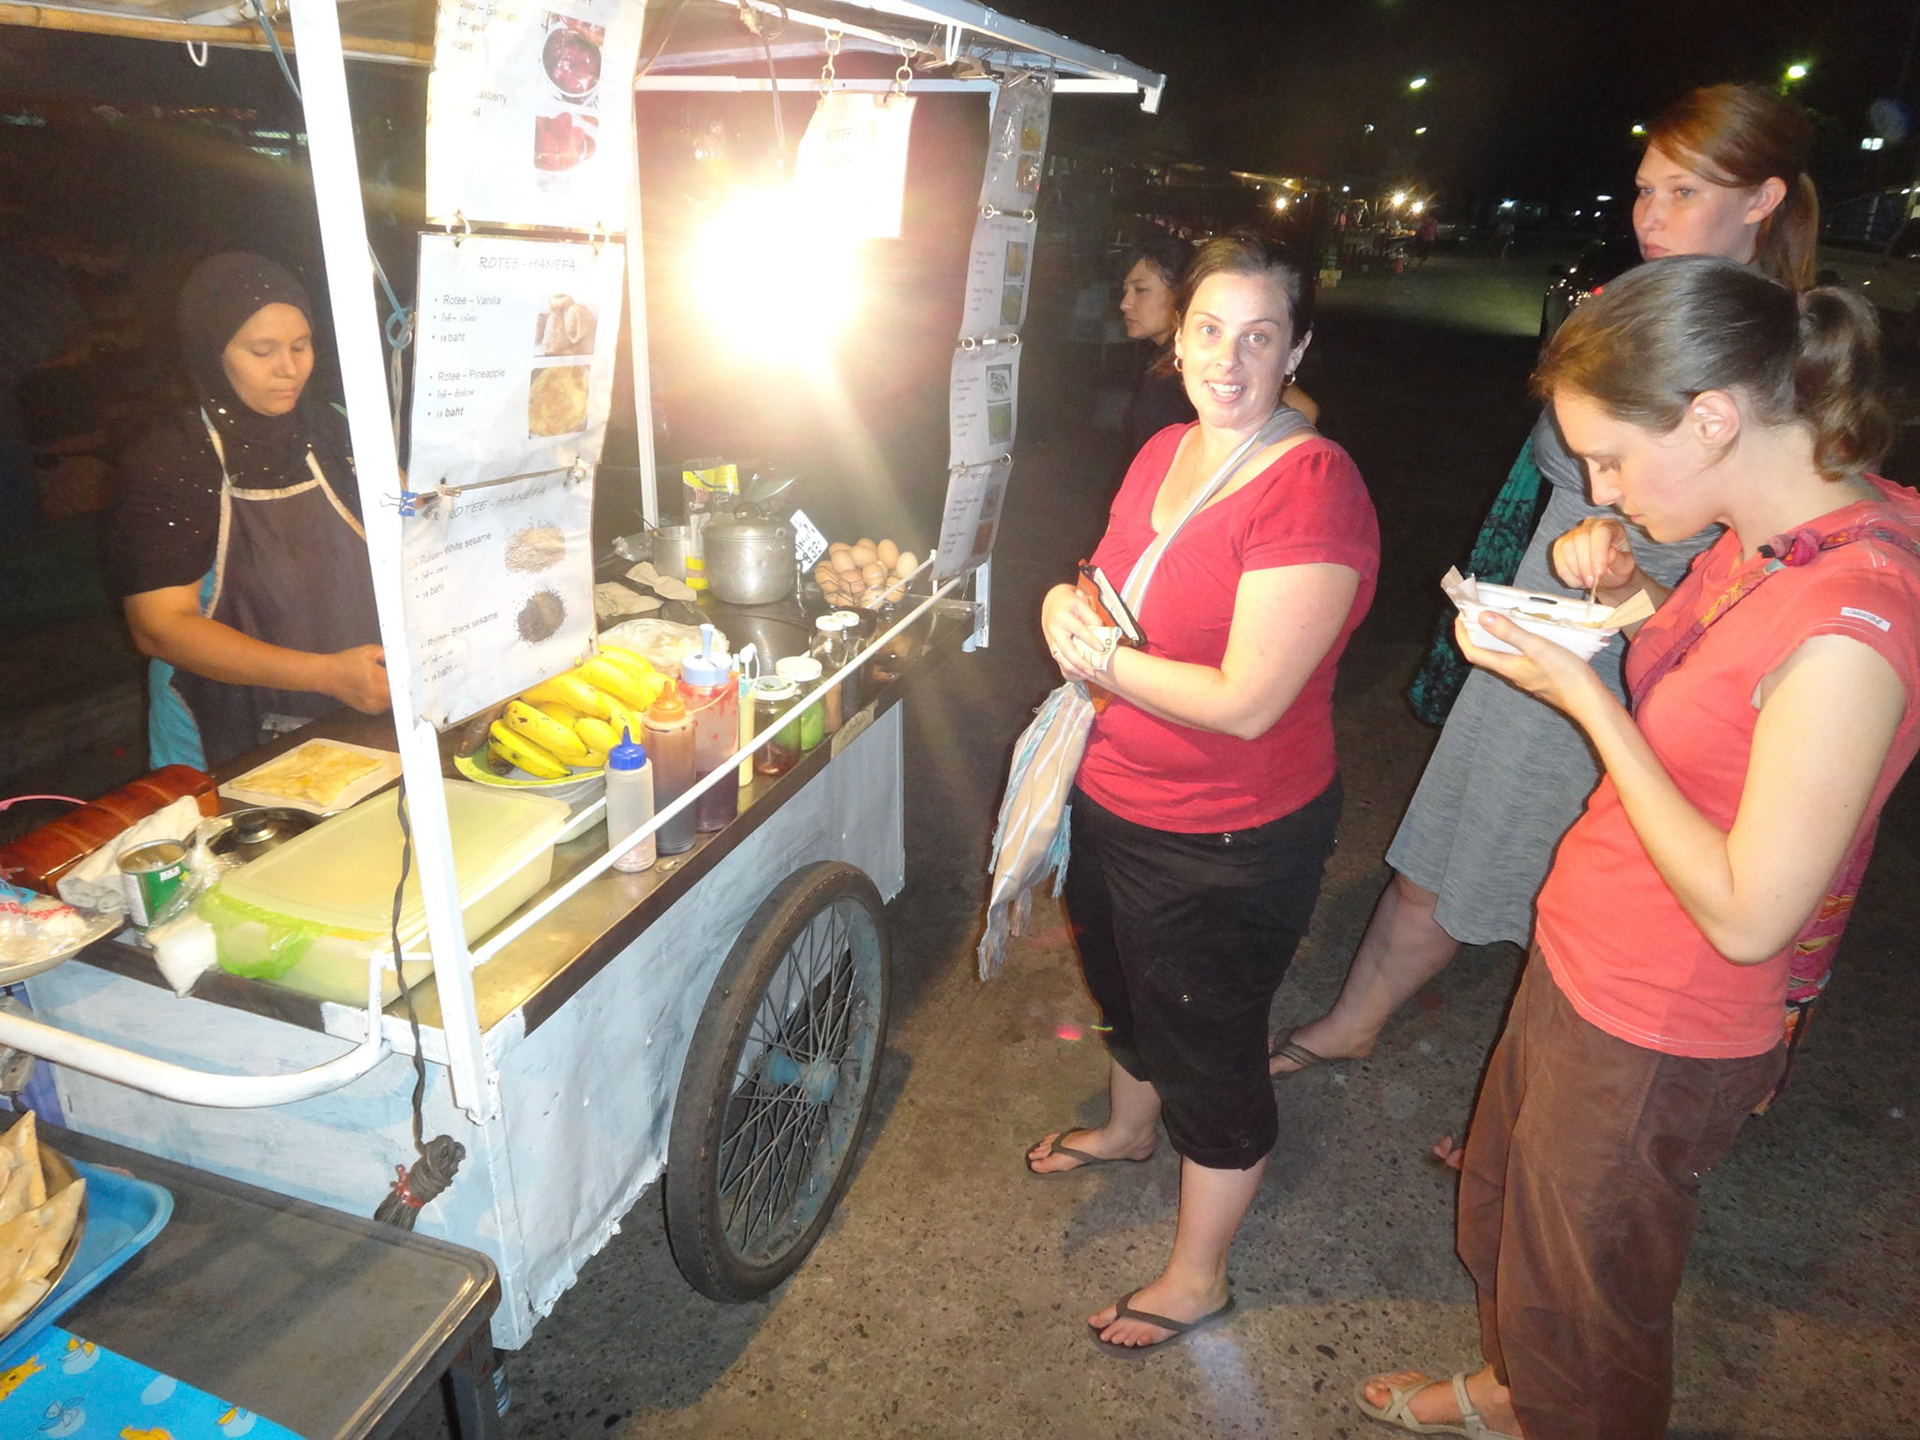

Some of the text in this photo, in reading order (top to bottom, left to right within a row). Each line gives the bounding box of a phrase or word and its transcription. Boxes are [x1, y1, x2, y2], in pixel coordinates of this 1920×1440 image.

[442, 294, 467, 306] Rotee
[476, 294, 501, 306] Vanilla
[448, 330, 466, 343] baht
[437, 371, 461, 382] Rotee
[469, 367, 506, 381] Pineapple
[444, 405, 465, 418] baht
[444, 541, 464, 555] White
[464, 532, 492, 548] sesame
[451, 623, 471, 637] Black
[471, 612, 498, 629] sesame
